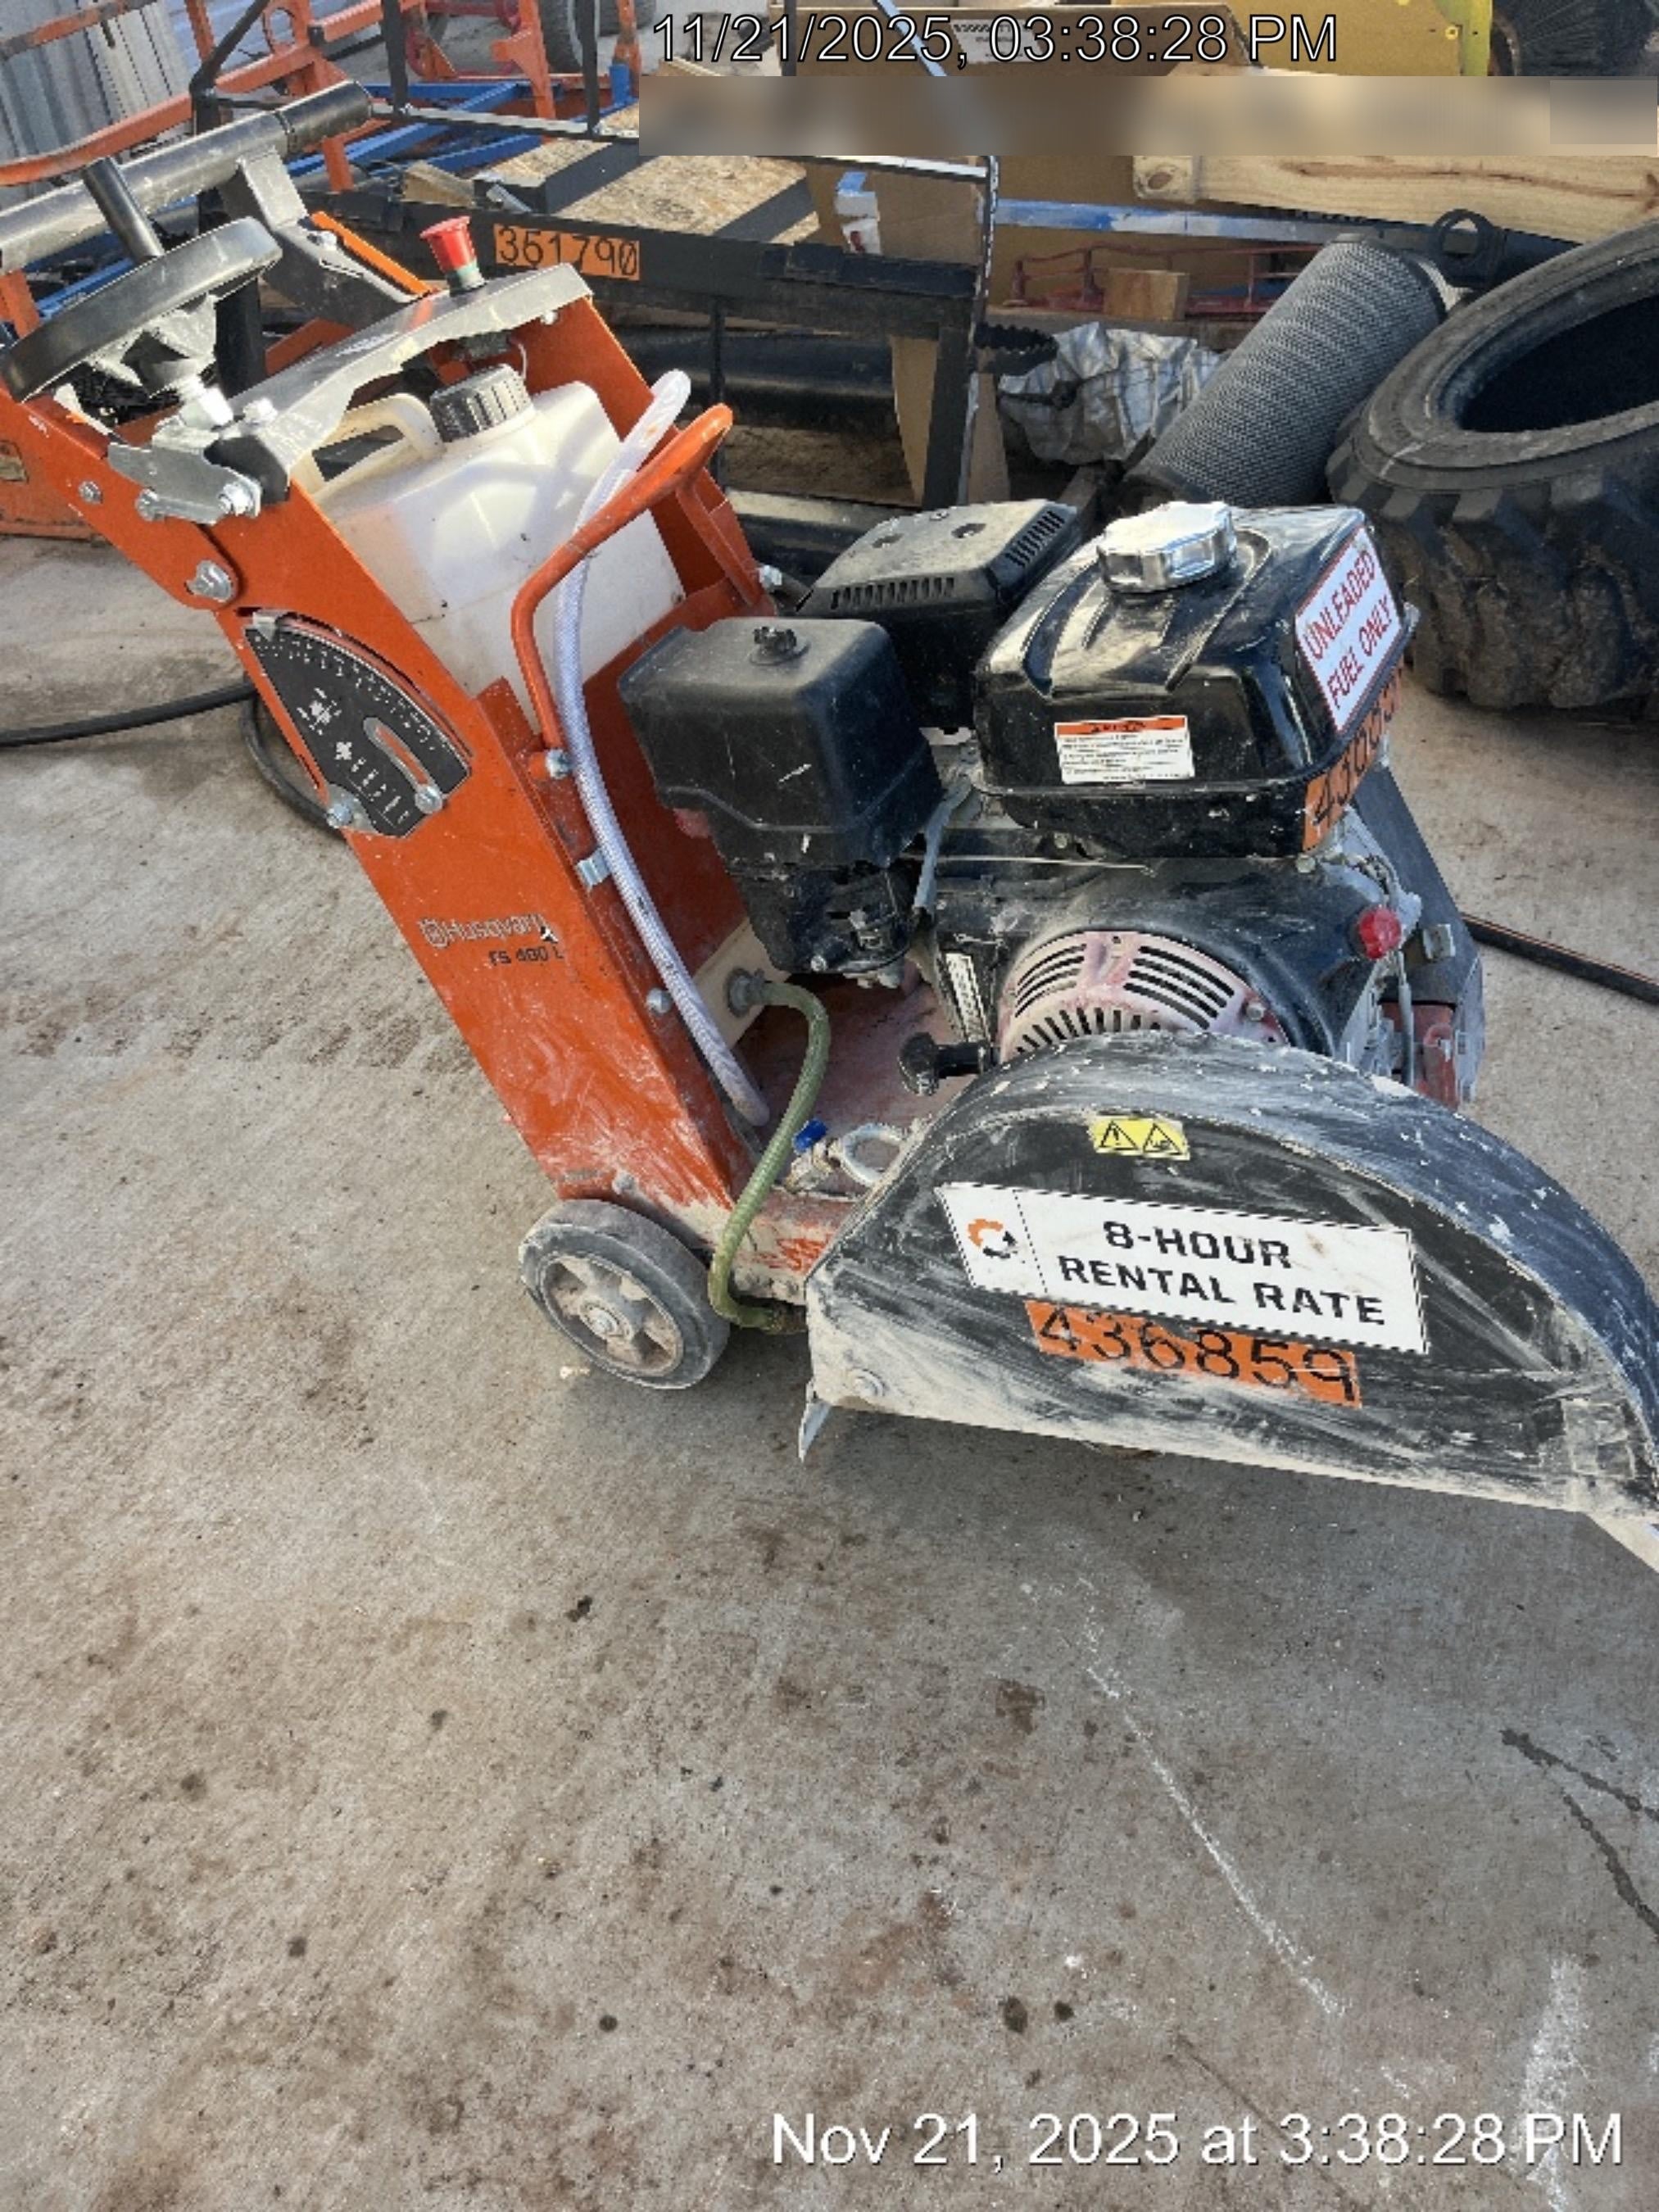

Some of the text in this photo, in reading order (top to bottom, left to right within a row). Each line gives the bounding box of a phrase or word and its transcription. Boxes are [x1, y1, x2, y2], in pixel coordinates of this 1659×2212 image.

[1303, 550, 1375, 660] UNLEADED
[1327, 594, 1392, 709] FUEL ONLY
[1057, 1254, 1385, 1326] RENTAL RATE
[1103, 1220, 1292, 1269] 8-HOUR
[1040, 1307, 1357, 1403] 436859
